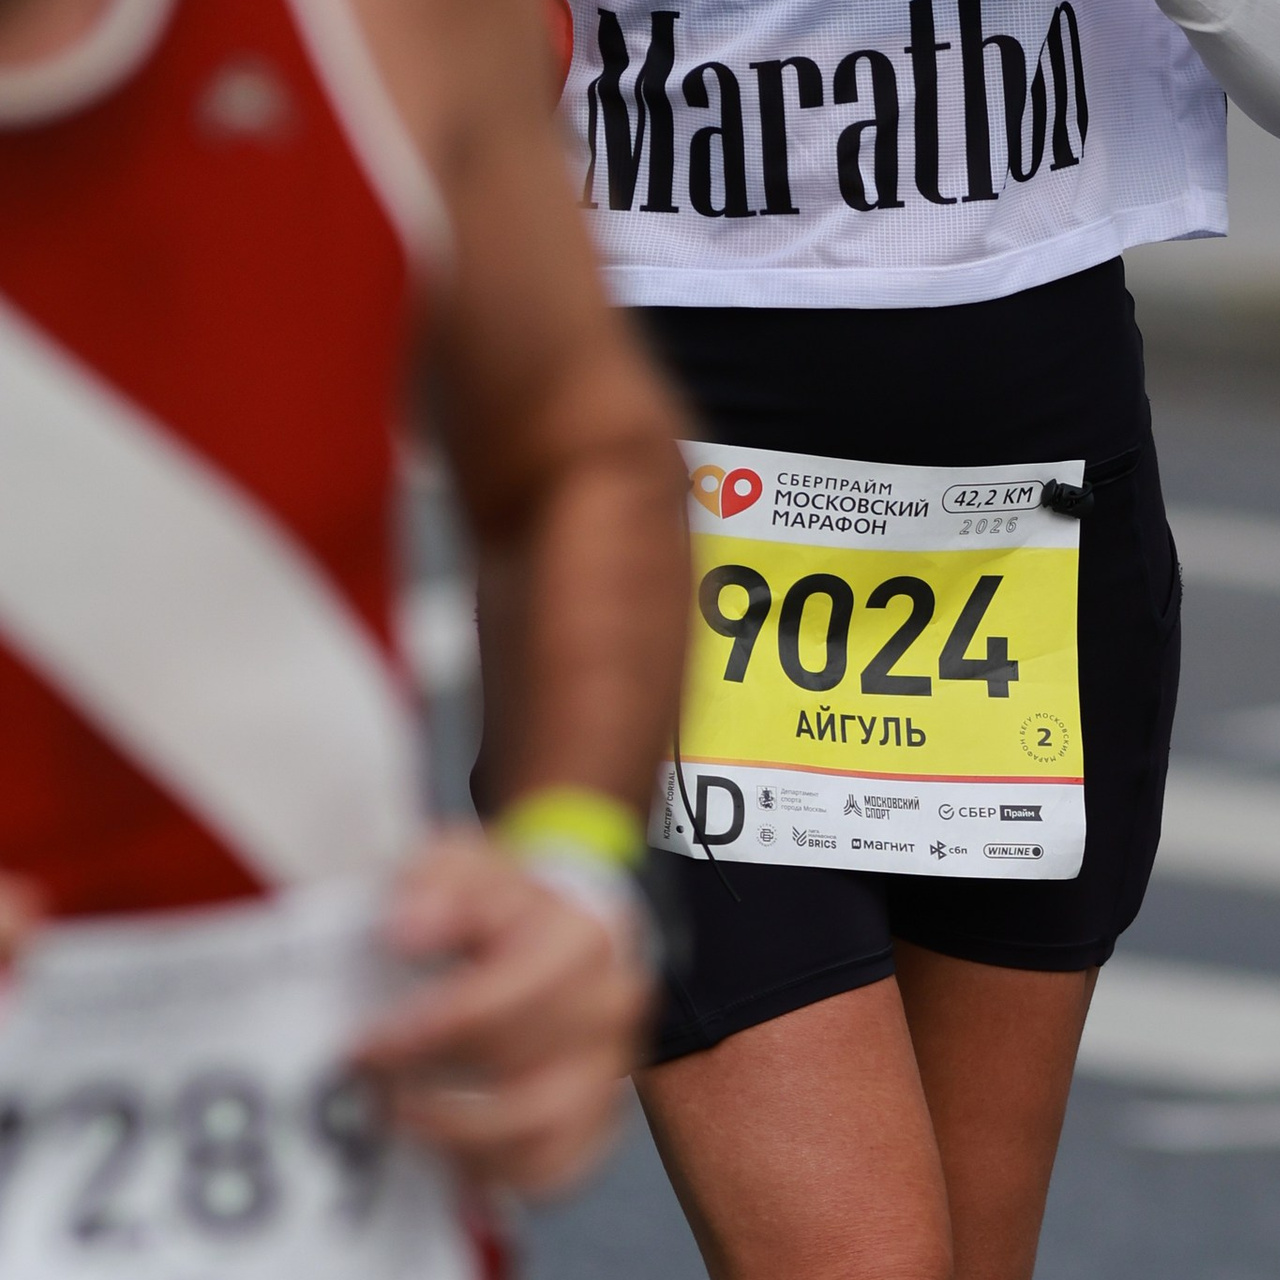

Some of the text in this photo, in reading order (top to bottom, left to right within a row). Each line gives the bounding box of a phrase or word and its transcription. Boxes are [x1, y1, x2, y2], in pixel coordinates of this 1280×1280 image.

[777, 472, 893, 496] СБЕРПРАЙМ
[774, 489, 930, 518] МОСКОВСКИЙ
[953, 489, 997, 508] 42,2
[772, 509, 887, 536] МАРАФОН
[698, 564, 1020, 698] 9024
[795, 704, 928, 748] АЙГУЛЬ
[1037, 727, 1053, 747] 2
[667, 771, 676, 802] CORRAL
[693, 774, 745, 846] D
[864, 795, 920, 811] МОСКОВСКИЙ
[865, 807, 891, 820] СПОРТ
[958, 807, 1035, 819] СБЕР Прайм
[663, 807, 674, 840] КЛАСТЕР
[808, 839, 837, 850] BRICS
[949, 846, 968, 855] сбп
[988, 847, 1030, 856] WINLINE
